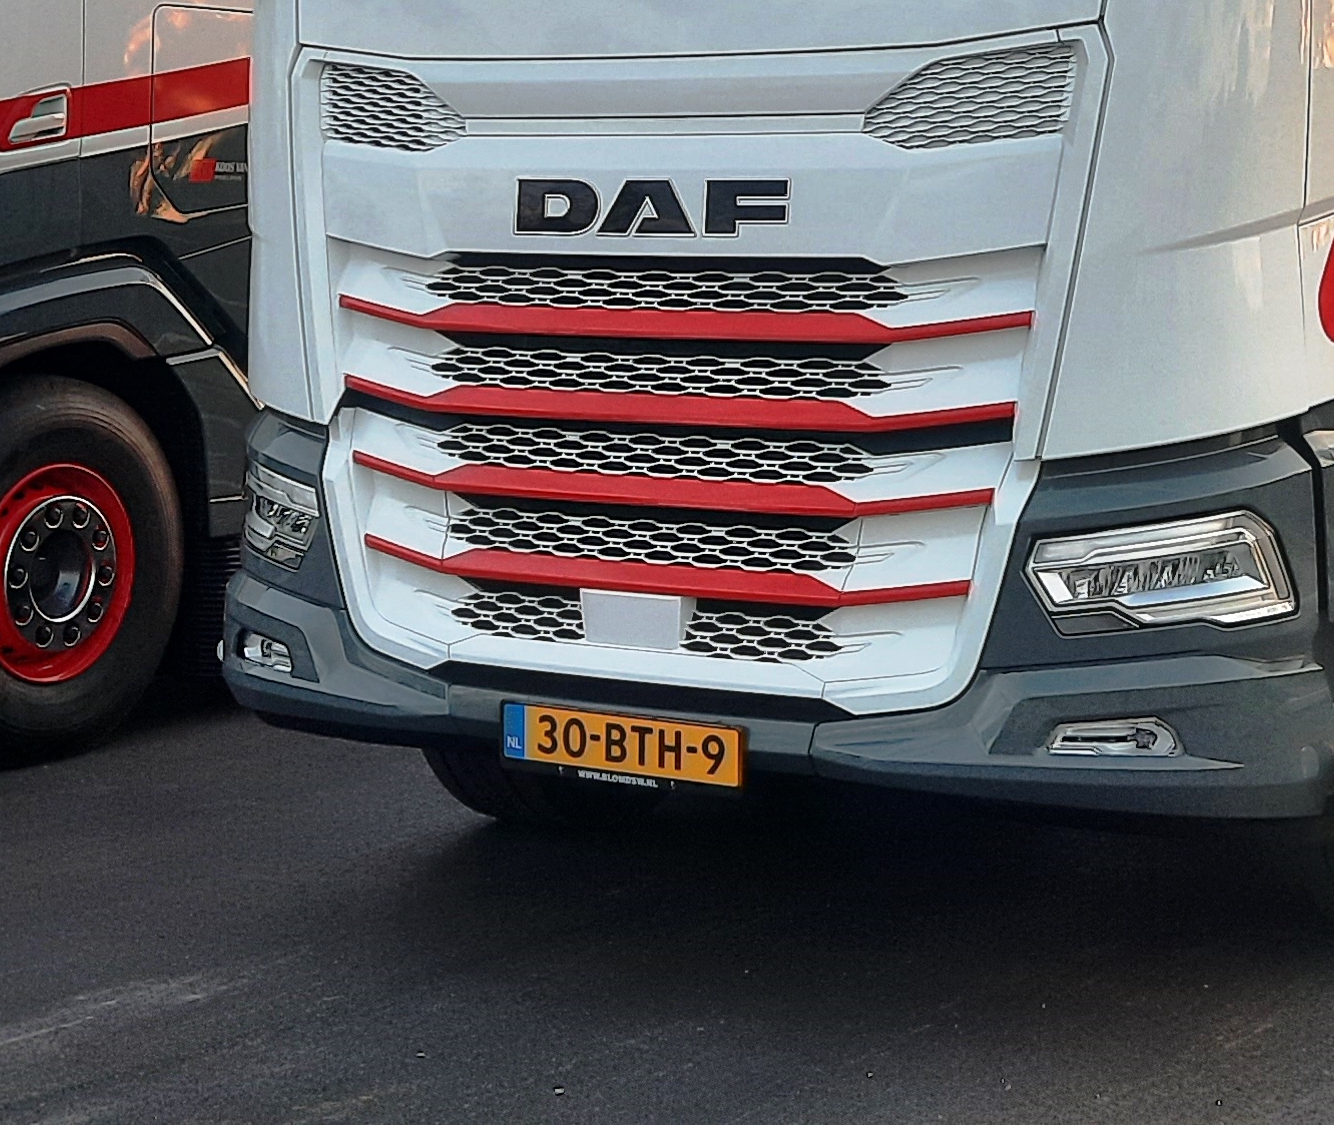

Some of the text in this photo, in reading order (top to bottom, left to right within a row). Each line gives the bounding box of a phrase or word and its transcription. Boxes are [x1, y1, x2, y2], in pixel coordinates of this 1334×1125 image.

[514, 178, 791, 237] DAF
[506, 735, 522, 750] NL
[537, 714, 726, 775] 30-BTH-9
